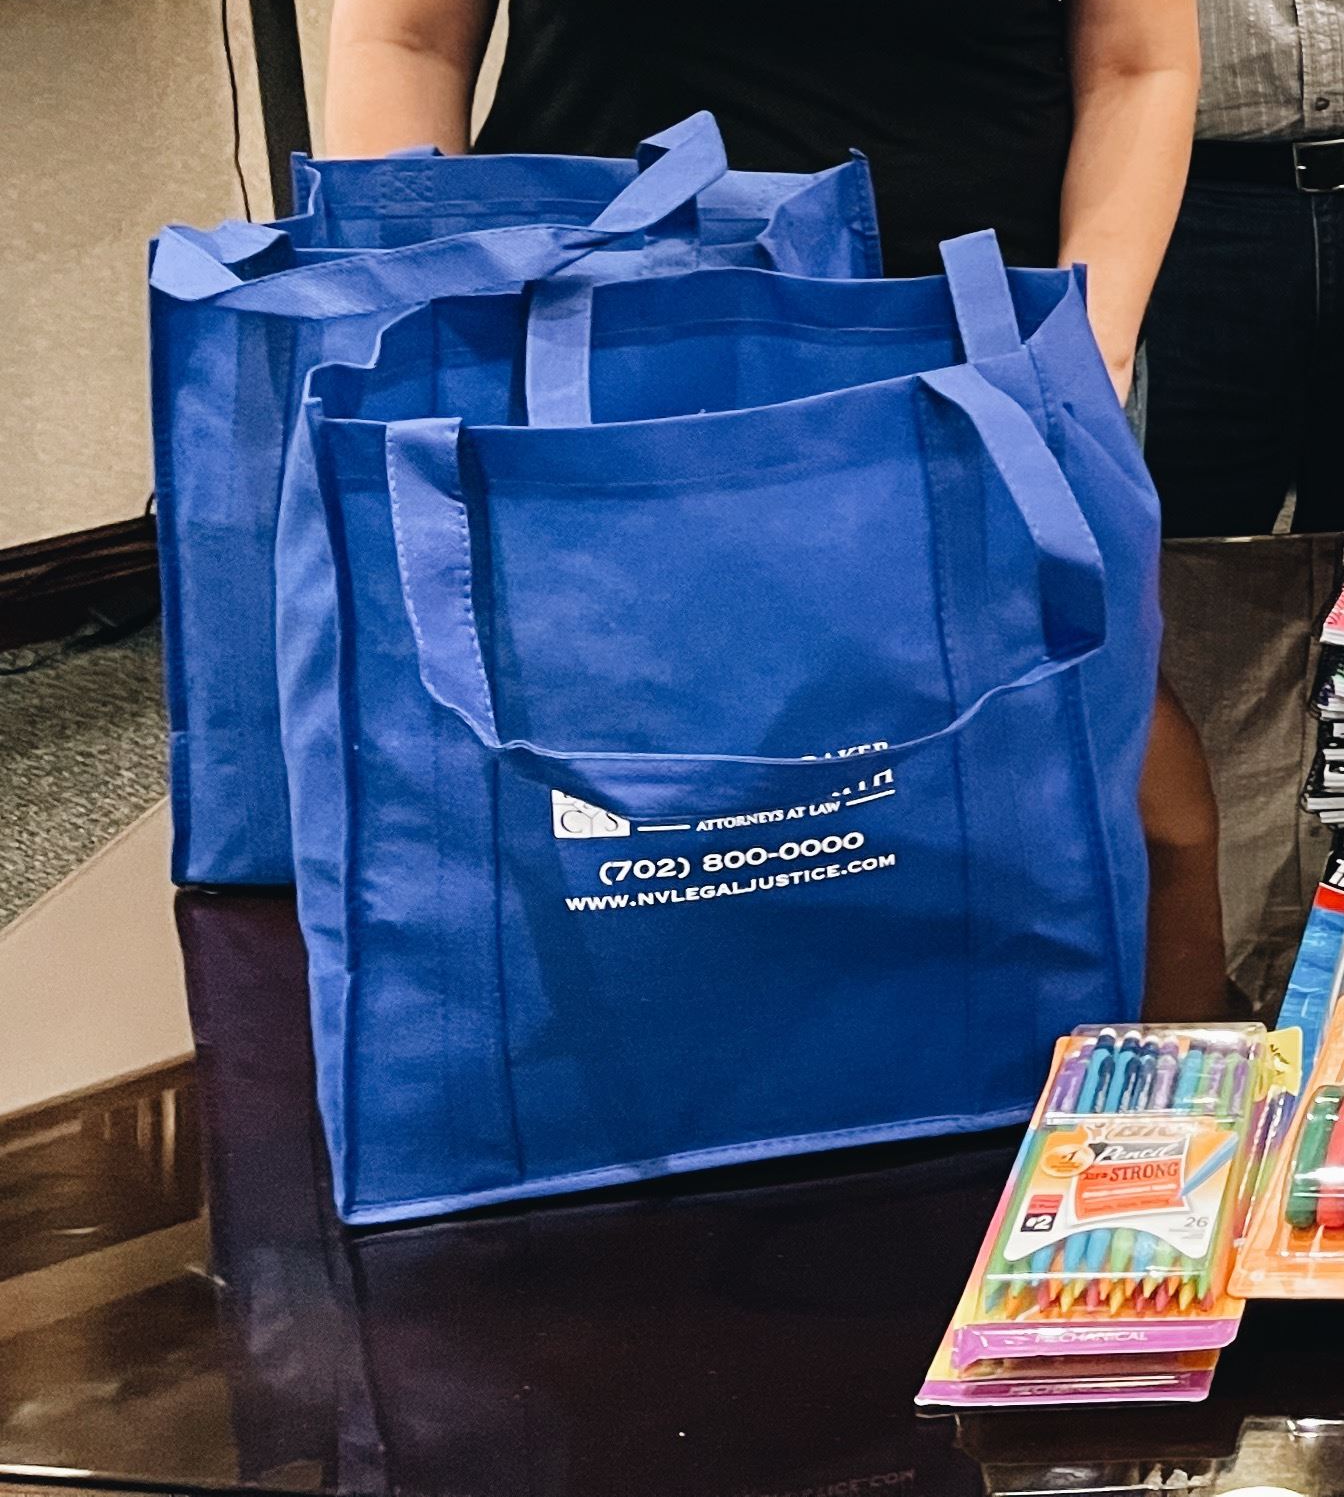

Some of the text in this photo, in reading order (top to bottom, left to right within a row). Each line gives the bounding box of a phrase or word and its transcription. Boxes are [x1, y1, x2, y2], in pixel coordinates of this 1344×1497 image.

[696, 801, 841, 832] ATTORNEYS AT LAW
[599, 831, 864, 885] (702) 800-0000
[565, 854, 896, 912] WWW.NVLEGALJUSTICE.COM
[1095, 1142, 1178, 1163] Pencil
[1109, 1162, 1179, 1182] STRONG
[1184, 1217, 1208, 1228] 26
